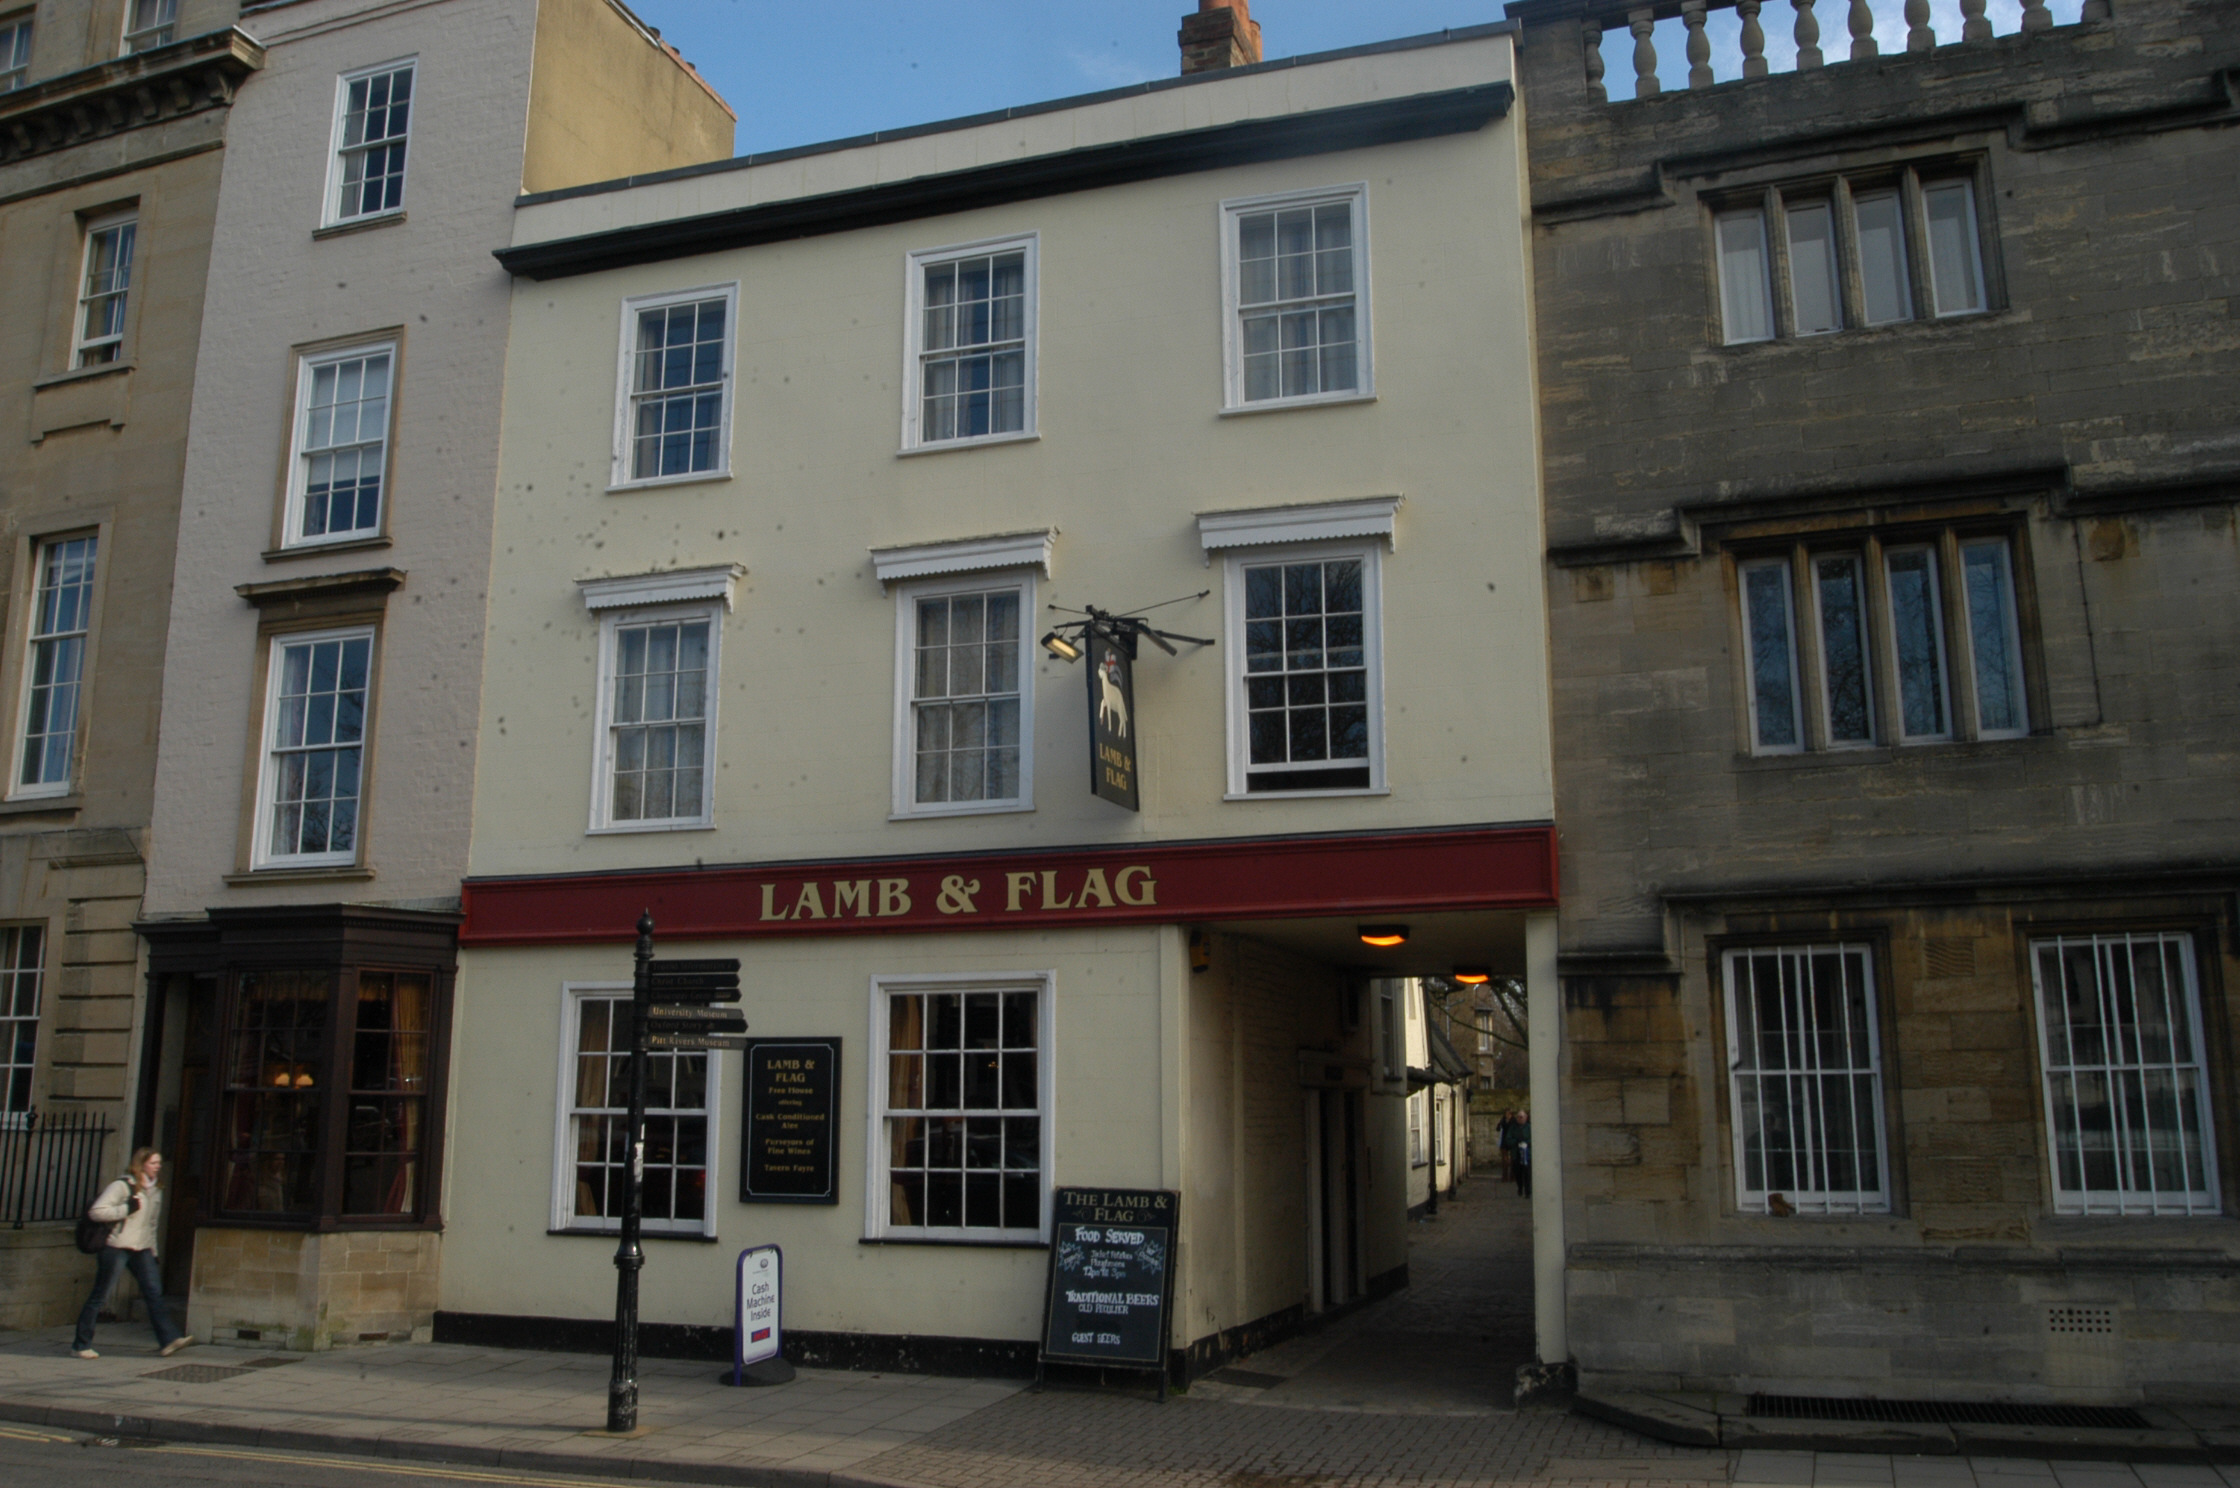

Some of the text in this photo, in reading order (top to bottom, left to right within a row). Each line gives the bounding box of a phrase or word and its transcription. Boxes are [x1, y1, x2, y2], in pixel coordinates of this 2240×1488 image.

[1099, 743, 1131, 772] LAMB &
[1106, 767, 1127, 791] FLAG
[759, 865, 1158, 921] LAMB & FLAG
[653, 1007, 727, 1018] University Museum
[652, 1035, 730, 1047] Pitt Rivers Museum
[767, 1059, 815, 1070] LAMB &
[775, 1072, 806, 1083] FLAG
[768, 1086, 813, 1095] Free House
[755, 1112, 825, 1121] Cask Conditioned
[806, 1138, 815, 1146] of
[767, 1147, 811, 1155] Fine Wines
[764, 1164, 815, 1173] Tavern Fayre
[1063, 1191, 1168, 1209] THE LAMB &
[1093, 1207, 1135, 1222] FLAG
[1075, 1226, 1145, 1245] FOOD SERVED
[752, 1281, 770, 1295] Cash
[746, 1293, 775, 1310] Machine
[1065, 1289, 1160, 1306] TRADITIONAL BEERS
[750, 1307, 771, 1321] Inside
[1078, 1304, 1093, 1313] OLD
[1071, 1332, 1121, 1345] GUEST BEERS
